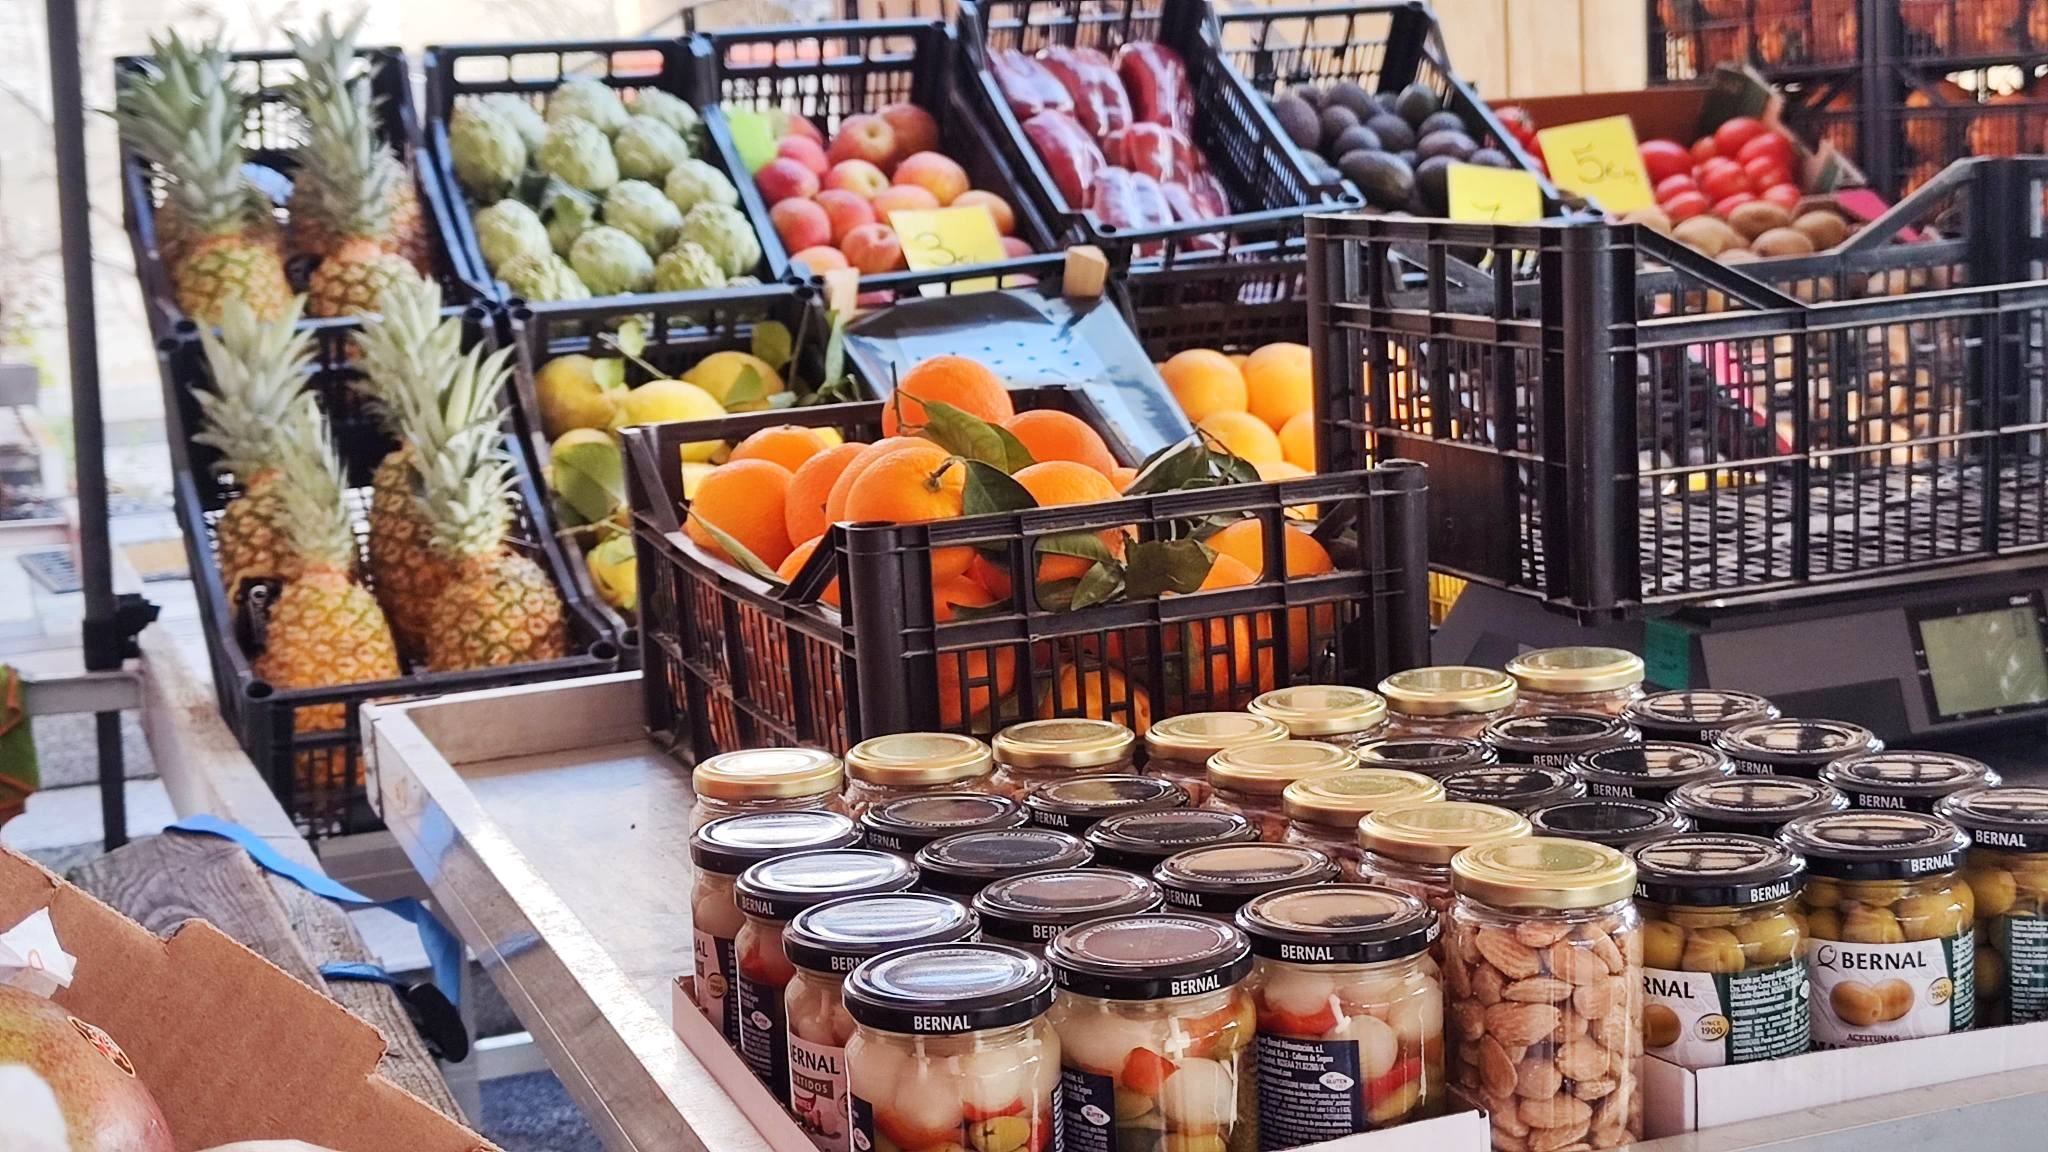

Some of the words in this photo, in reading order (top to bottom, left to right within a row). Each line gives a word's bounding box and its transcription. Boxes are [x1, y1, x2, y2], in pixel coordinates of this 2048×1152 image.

[1736, 760, 1774, 775] BERNAL
[1593, 783, 1635, 799] BERNAL
[1859, 794, 1907, 809] BERNAL
[1034, 811, 1070, 827] BERNAL
[868, 832, 901, 850] BERNAL
[1976, 829, 2027, 847] BERNAL
[1911, 854, 1955, 873] BERNAL
[1165, 889, 1203, 907] BERNAL
[1750, 881, 1791, 903] BERNAL
[741, 897, 775, 916] BERNAL
[1281, 944, 1335, 961] BERNAL
[1842, 950, 1927, 970] BERNAL
[1171, 974, 1221, 996] BERNAL
[1931, 989, 1948, 999] 1900
[914, 1015, 972, 1031] BERNAL
[1700, 1026, 1723, 1035] 1900
